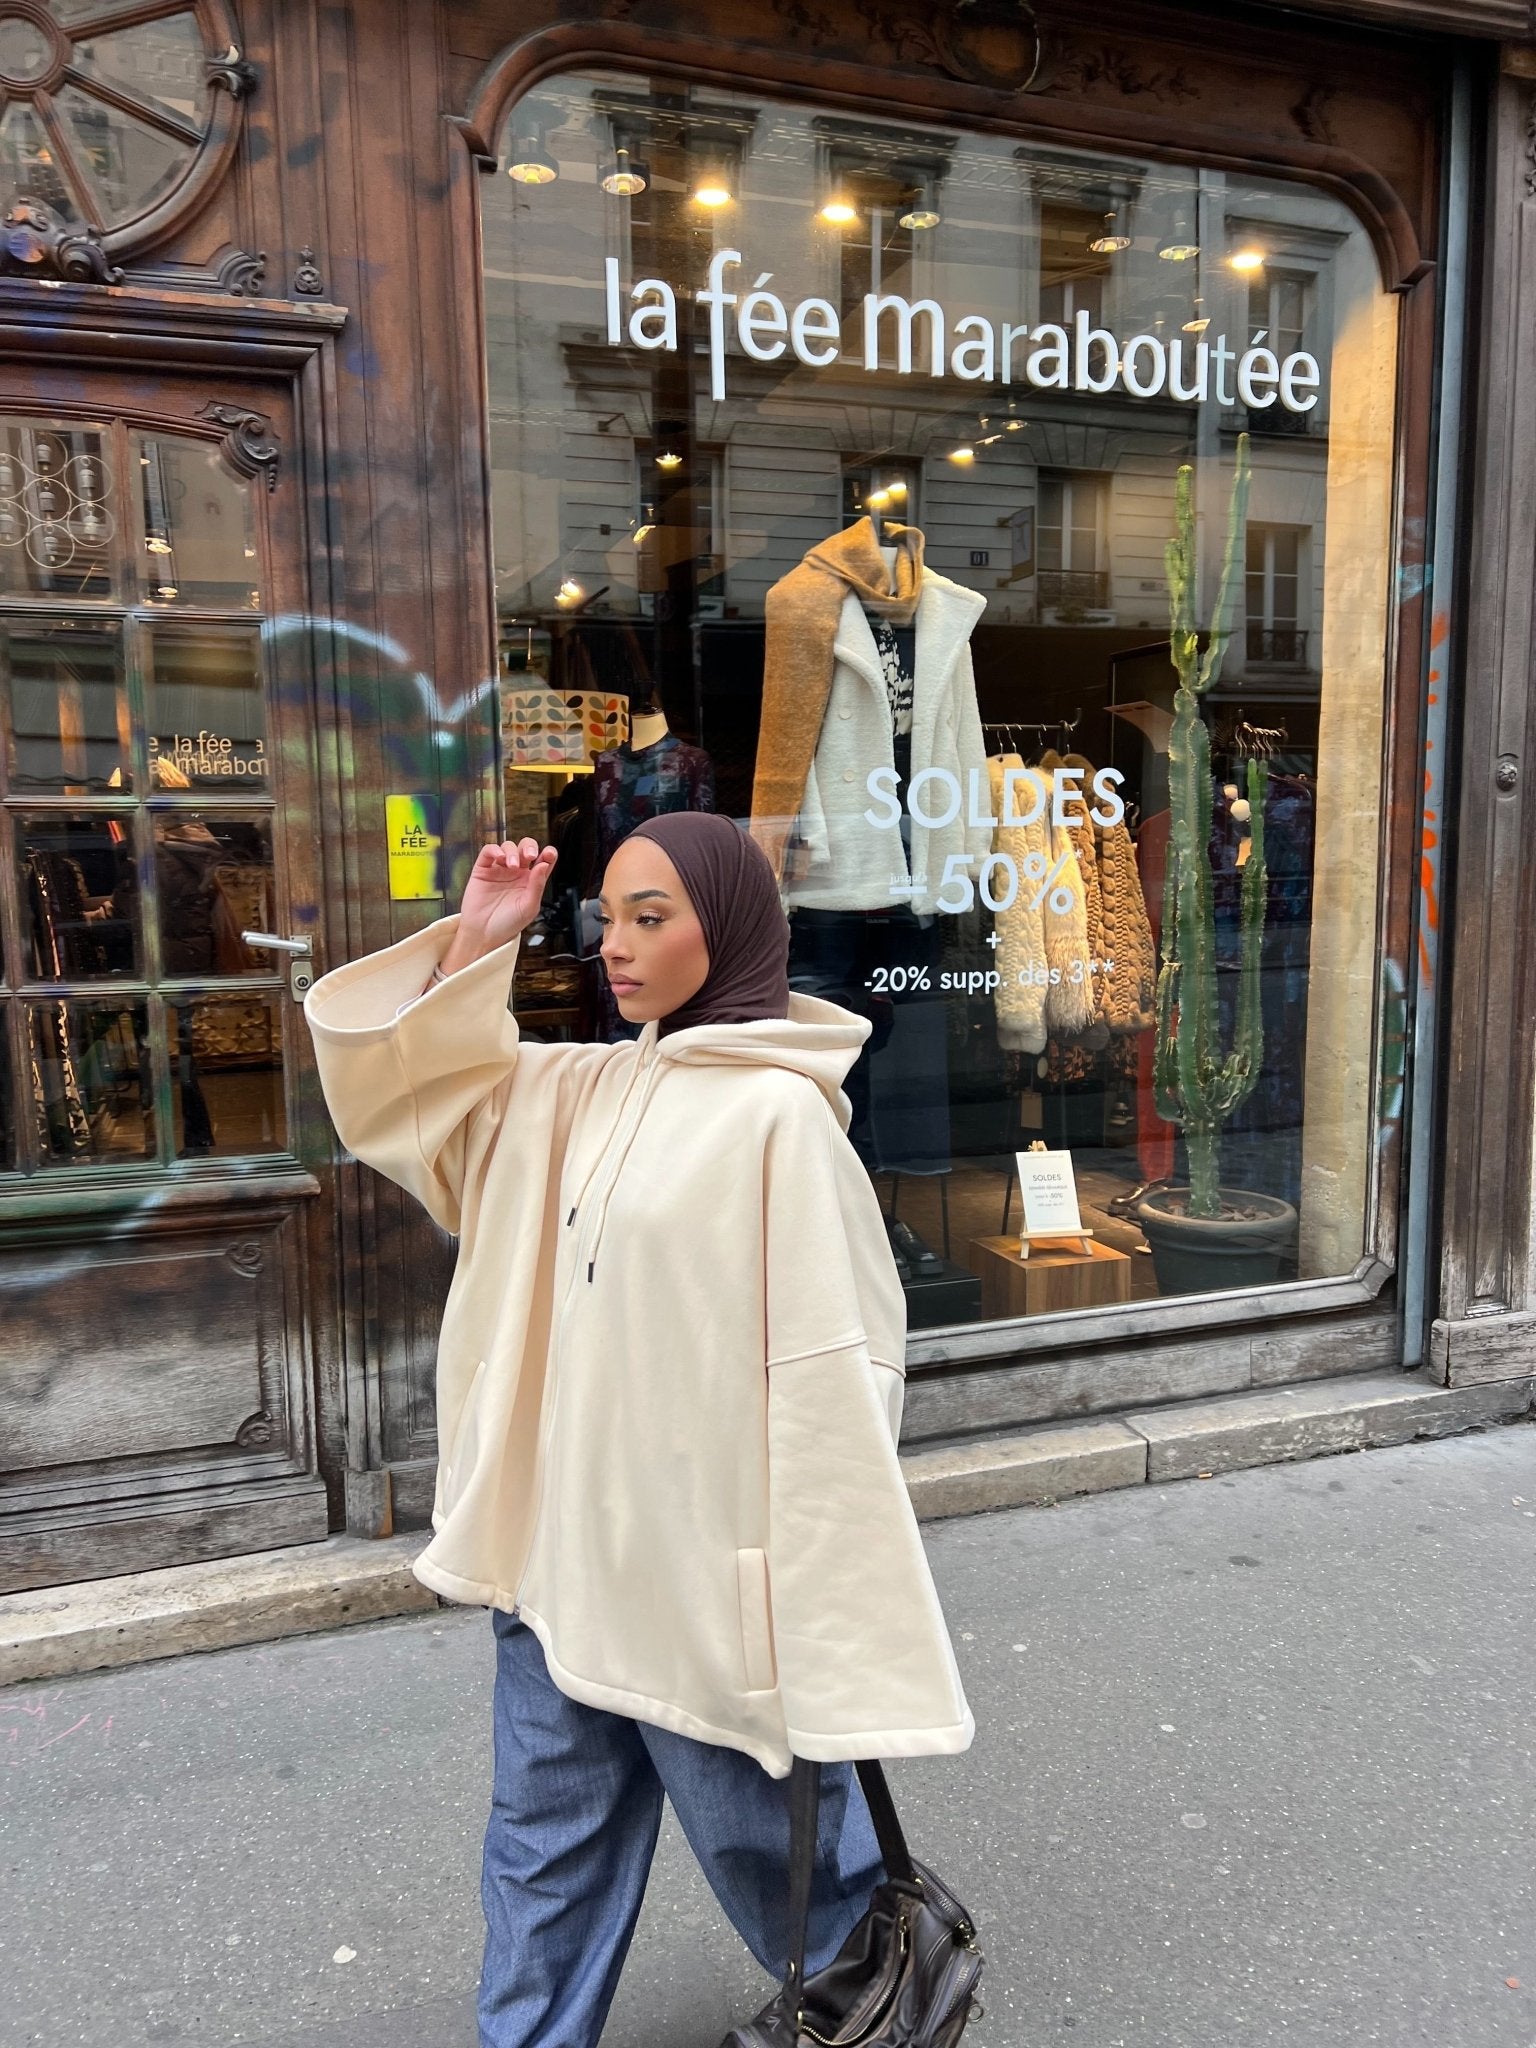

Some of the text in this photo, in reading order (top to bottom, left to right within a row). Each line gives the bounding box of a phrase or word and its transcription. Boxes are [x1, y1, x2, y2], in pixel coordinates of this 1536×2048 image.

[605, 250, 1321, 412] la fée maraboutée
[174, 730, 232, 763] la fée
[863, 767, 1126, 829] SOLDES
[401, 835, 427, 848] FÉE
[404, 824, 423, 835] LA
[864, 966, 931, 992] -20%
[939, 972, 1008, 995] supp.
[1018, 960, 1061, 986] dès
